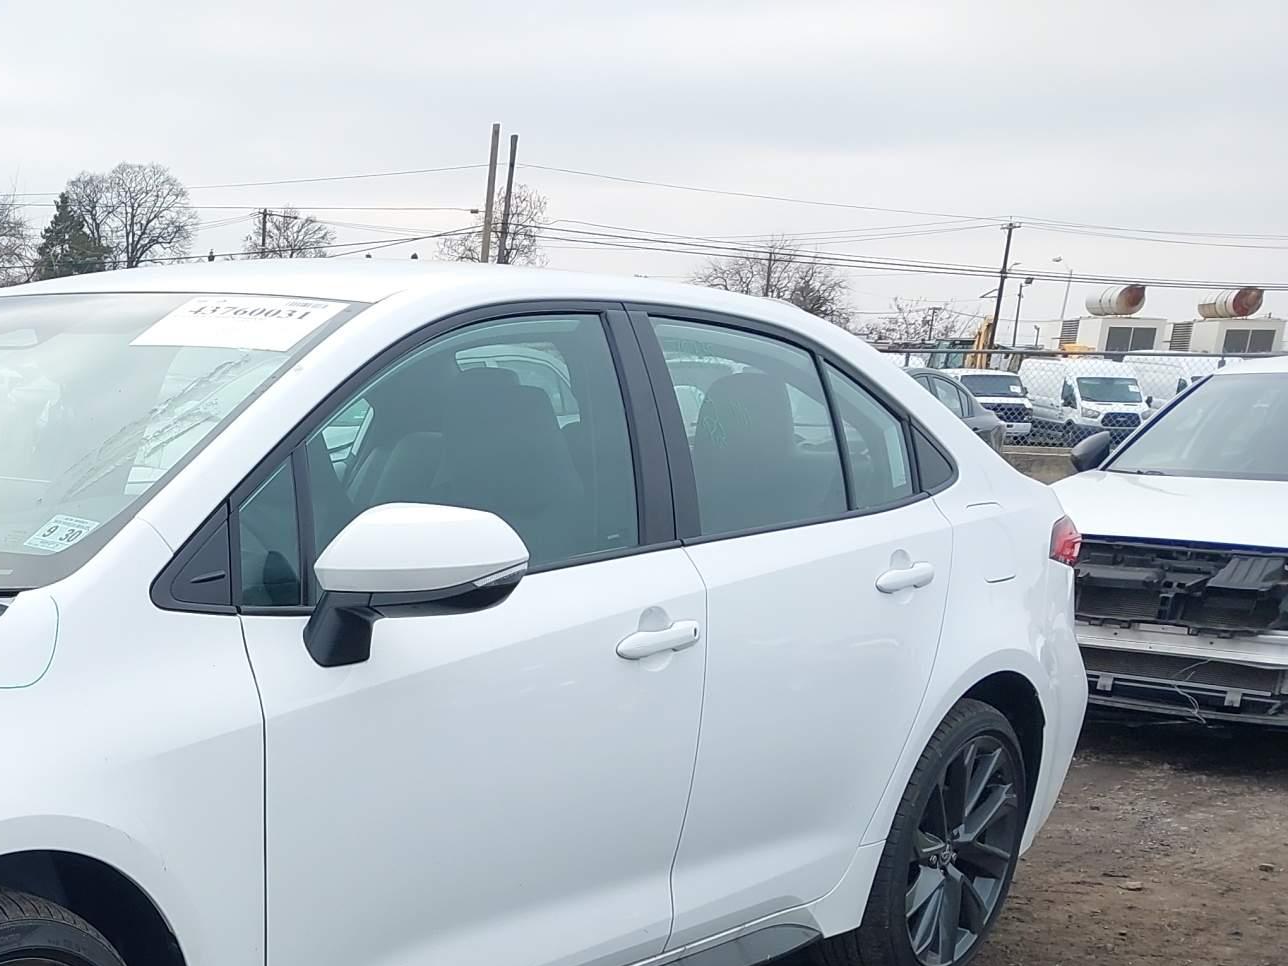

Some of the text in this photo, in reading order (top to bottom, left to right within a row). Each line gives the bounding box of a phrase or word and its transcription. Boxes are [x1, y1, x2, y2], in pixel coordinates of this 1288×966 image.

[189, 306, 311, 320] 43760031
[42, 525, 59, 538] 9
[58, 528, 83, 543] 30
